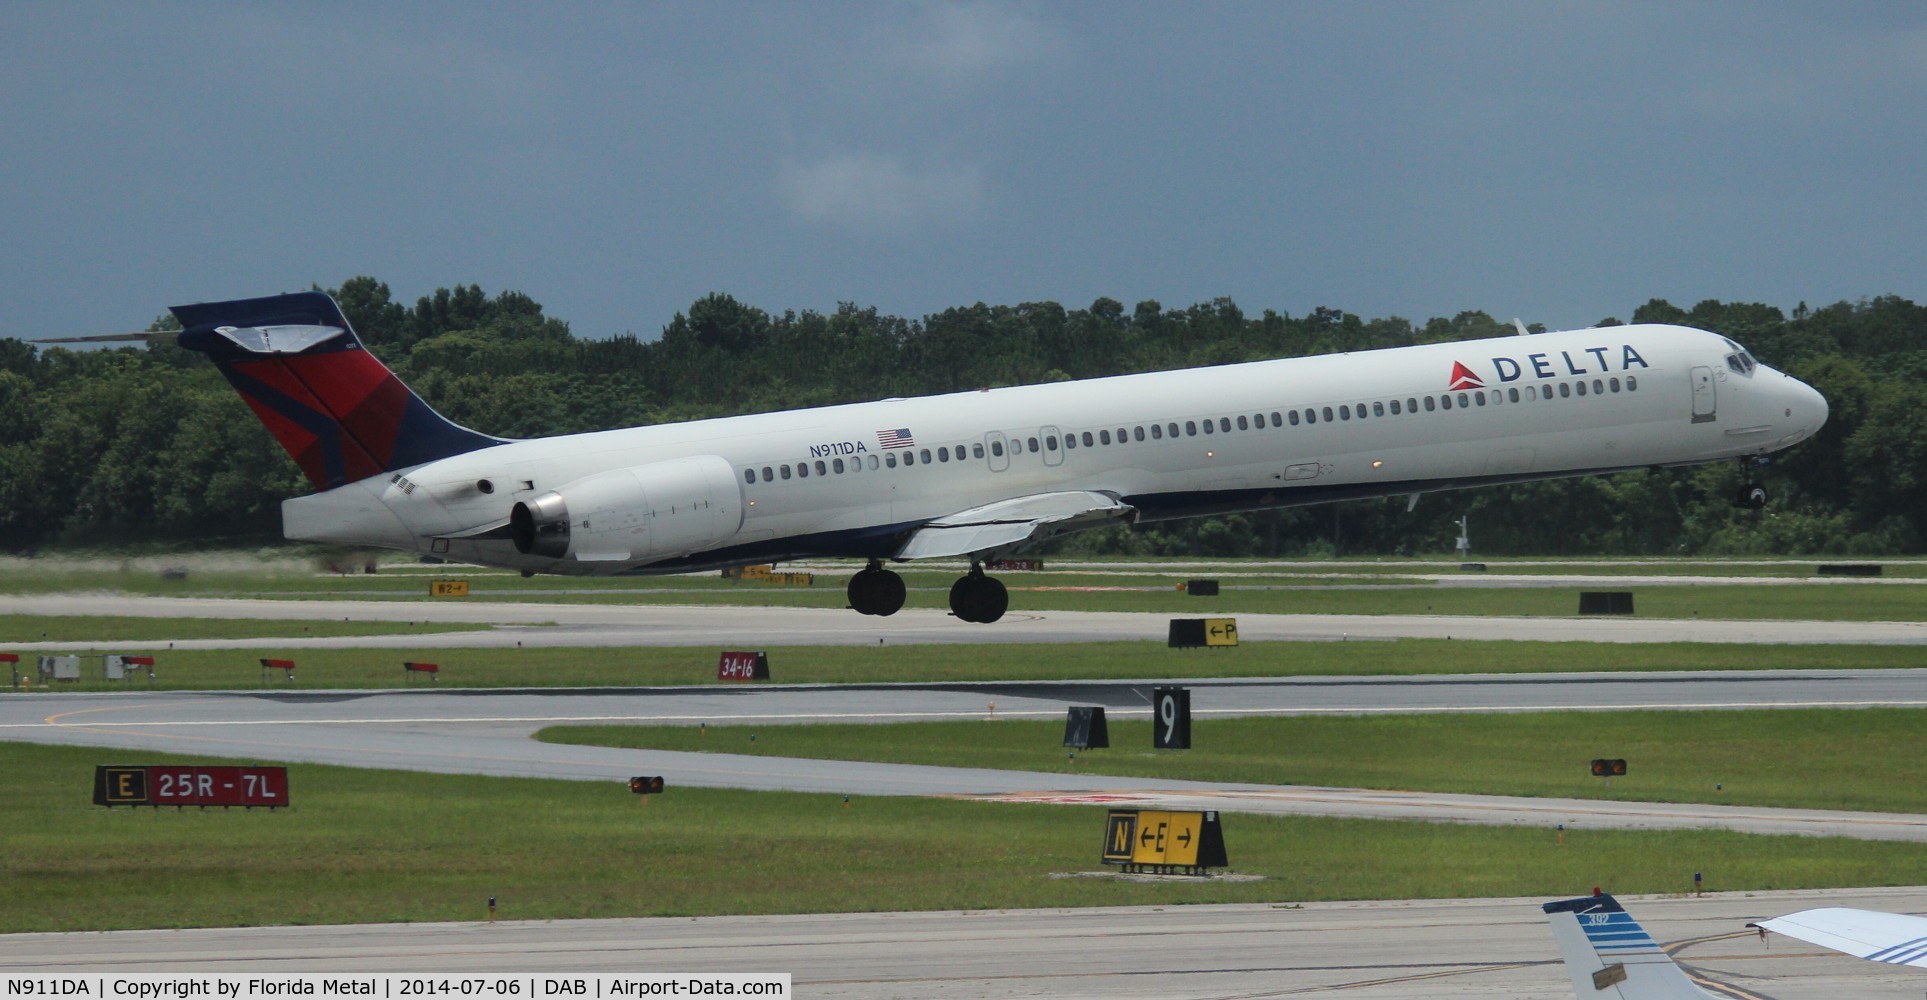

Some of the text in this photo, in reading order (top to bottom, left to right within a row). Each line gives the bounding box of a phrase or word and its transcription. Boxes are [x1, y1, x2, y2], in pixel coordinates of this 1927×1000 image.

[1491, 345, 1649, 382] DELTA
[810, 440, 867, 458] N911DA
[1225, 624, 1236, 639] P
[722, 657, 753, 677] 34-16
[1161, 695, 1175, 744] 9
[118, 774, 134, 796] E
[159, 774, 214, 797] 25R
[242, 775, 276, 797] 7L
[1114, 821, 1167, 852] N E
